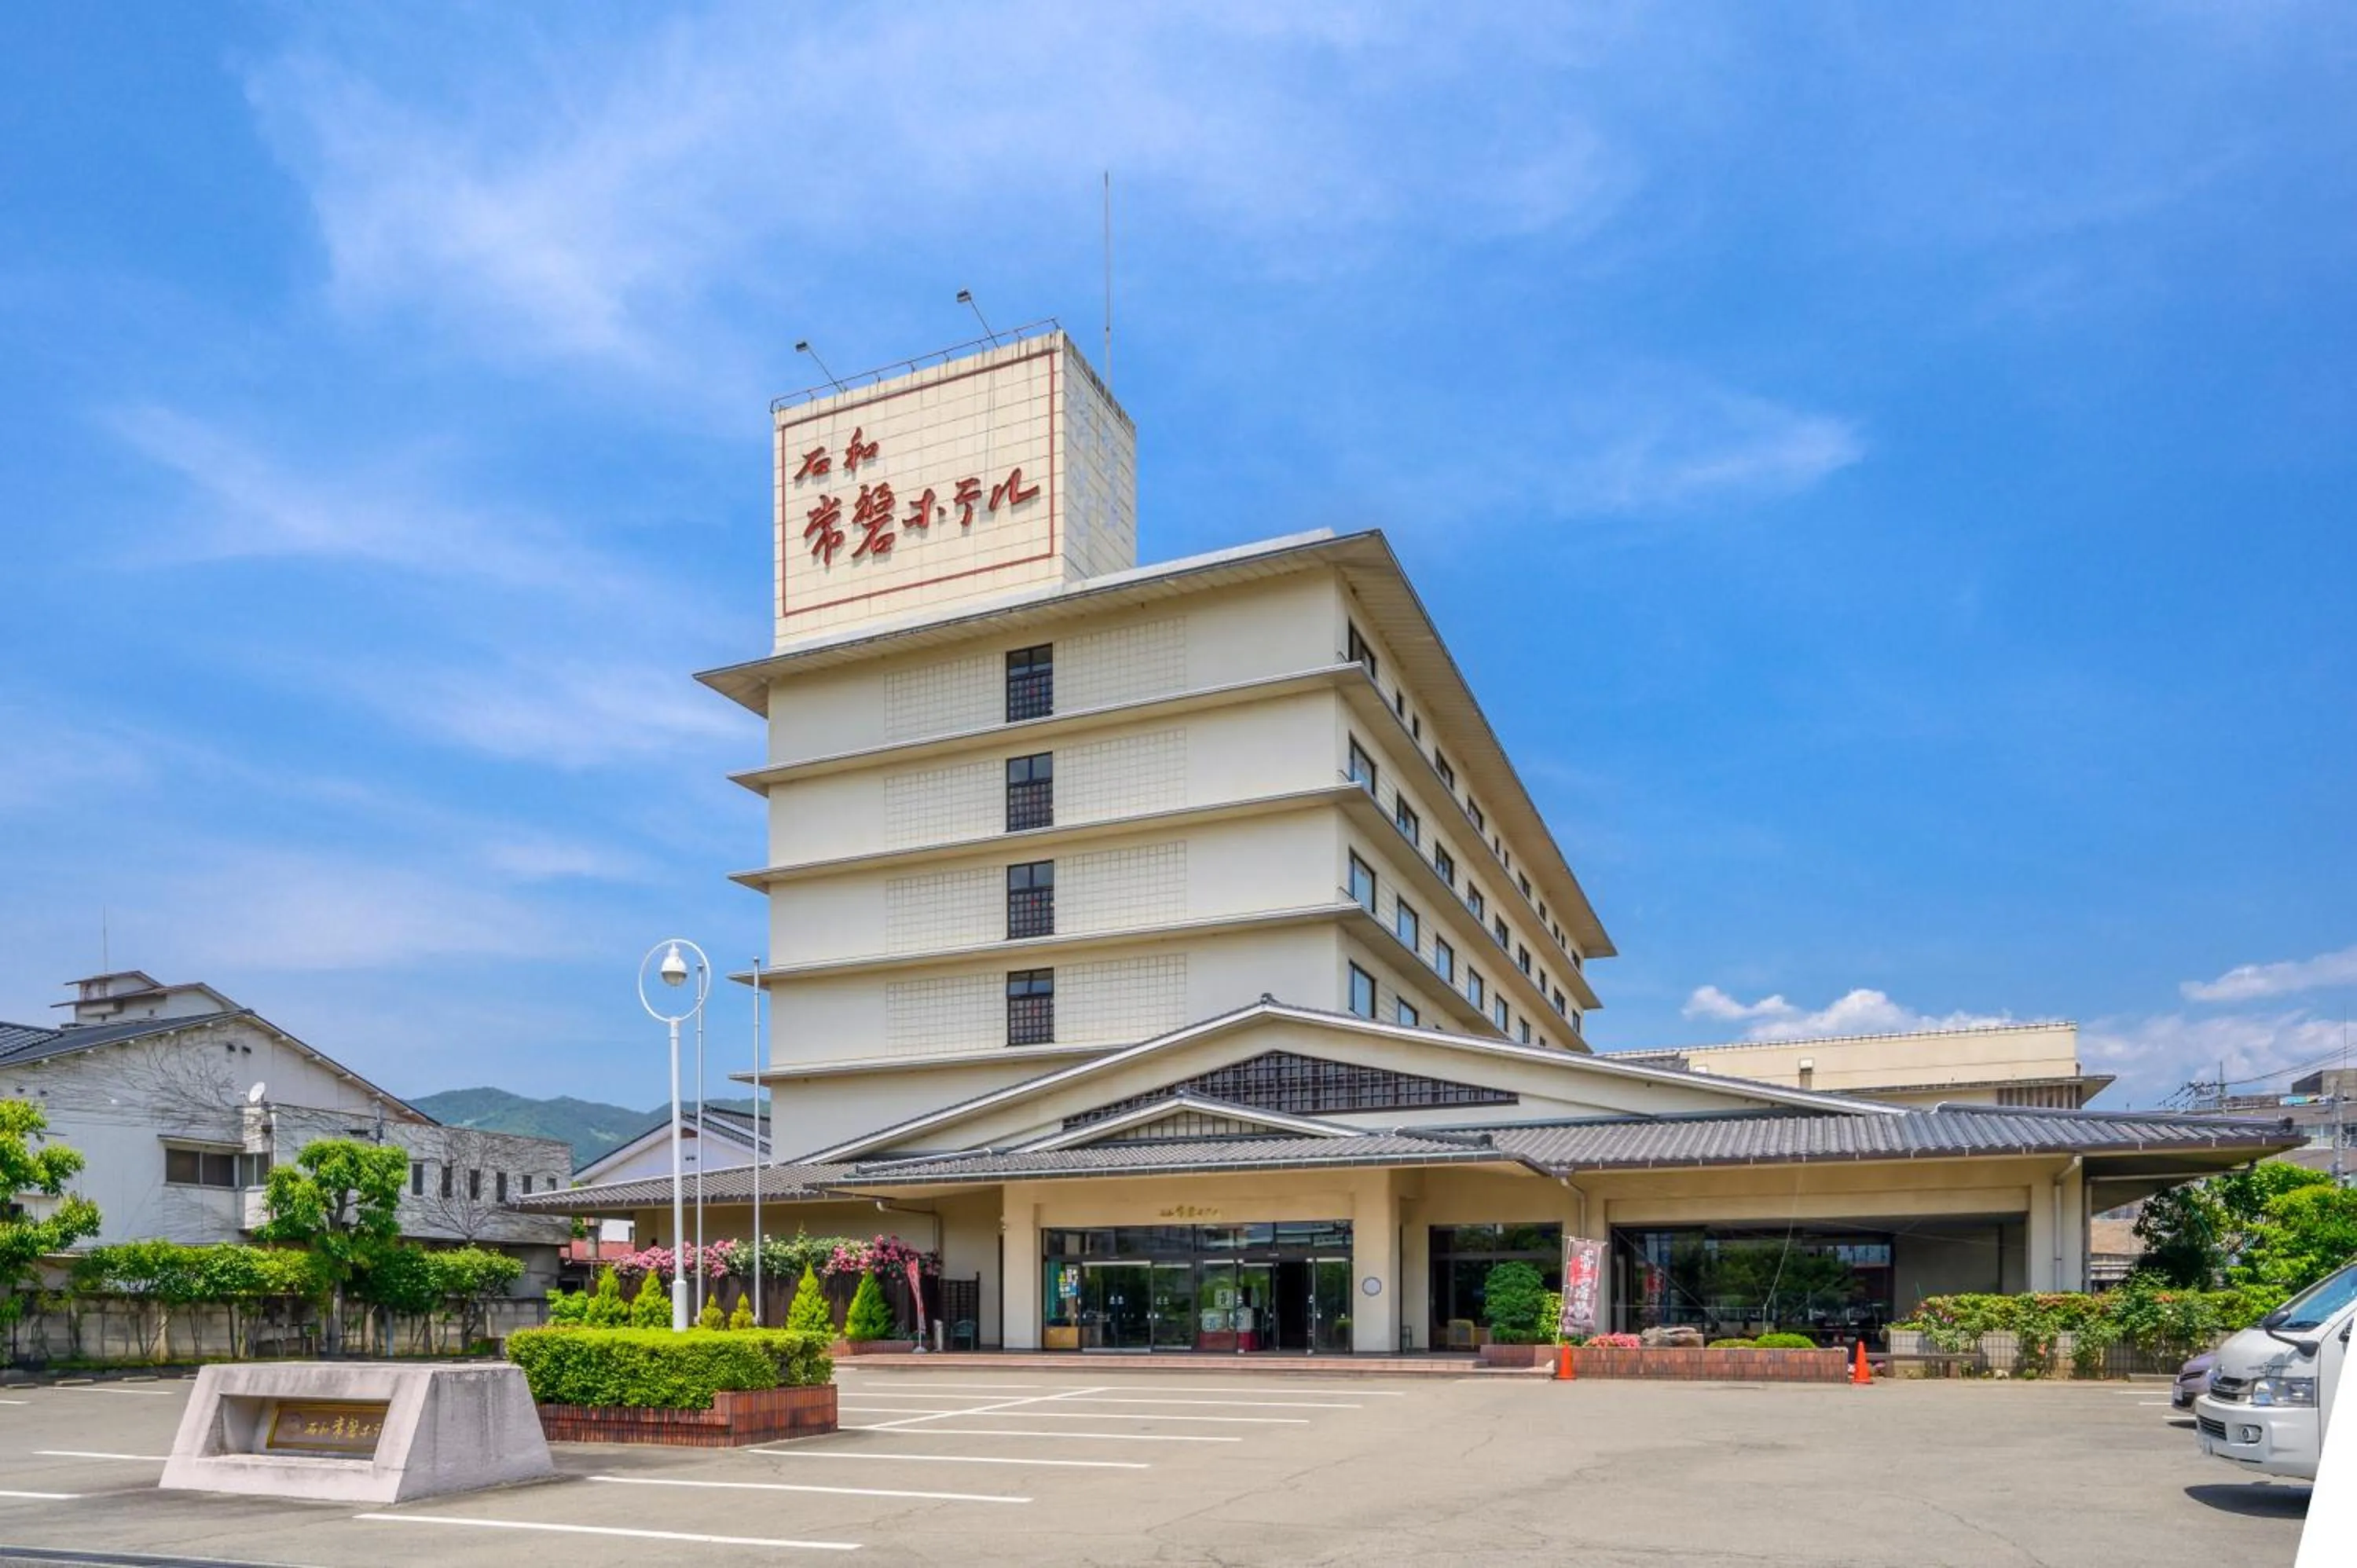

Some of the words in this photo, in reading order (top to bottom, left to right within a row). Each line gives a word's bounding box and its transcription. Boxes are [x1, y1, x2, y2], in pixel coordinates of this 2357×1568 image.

[794, 427, 879, 480] 石和
[804, 467, 1040, 566] 常磐ホテル
